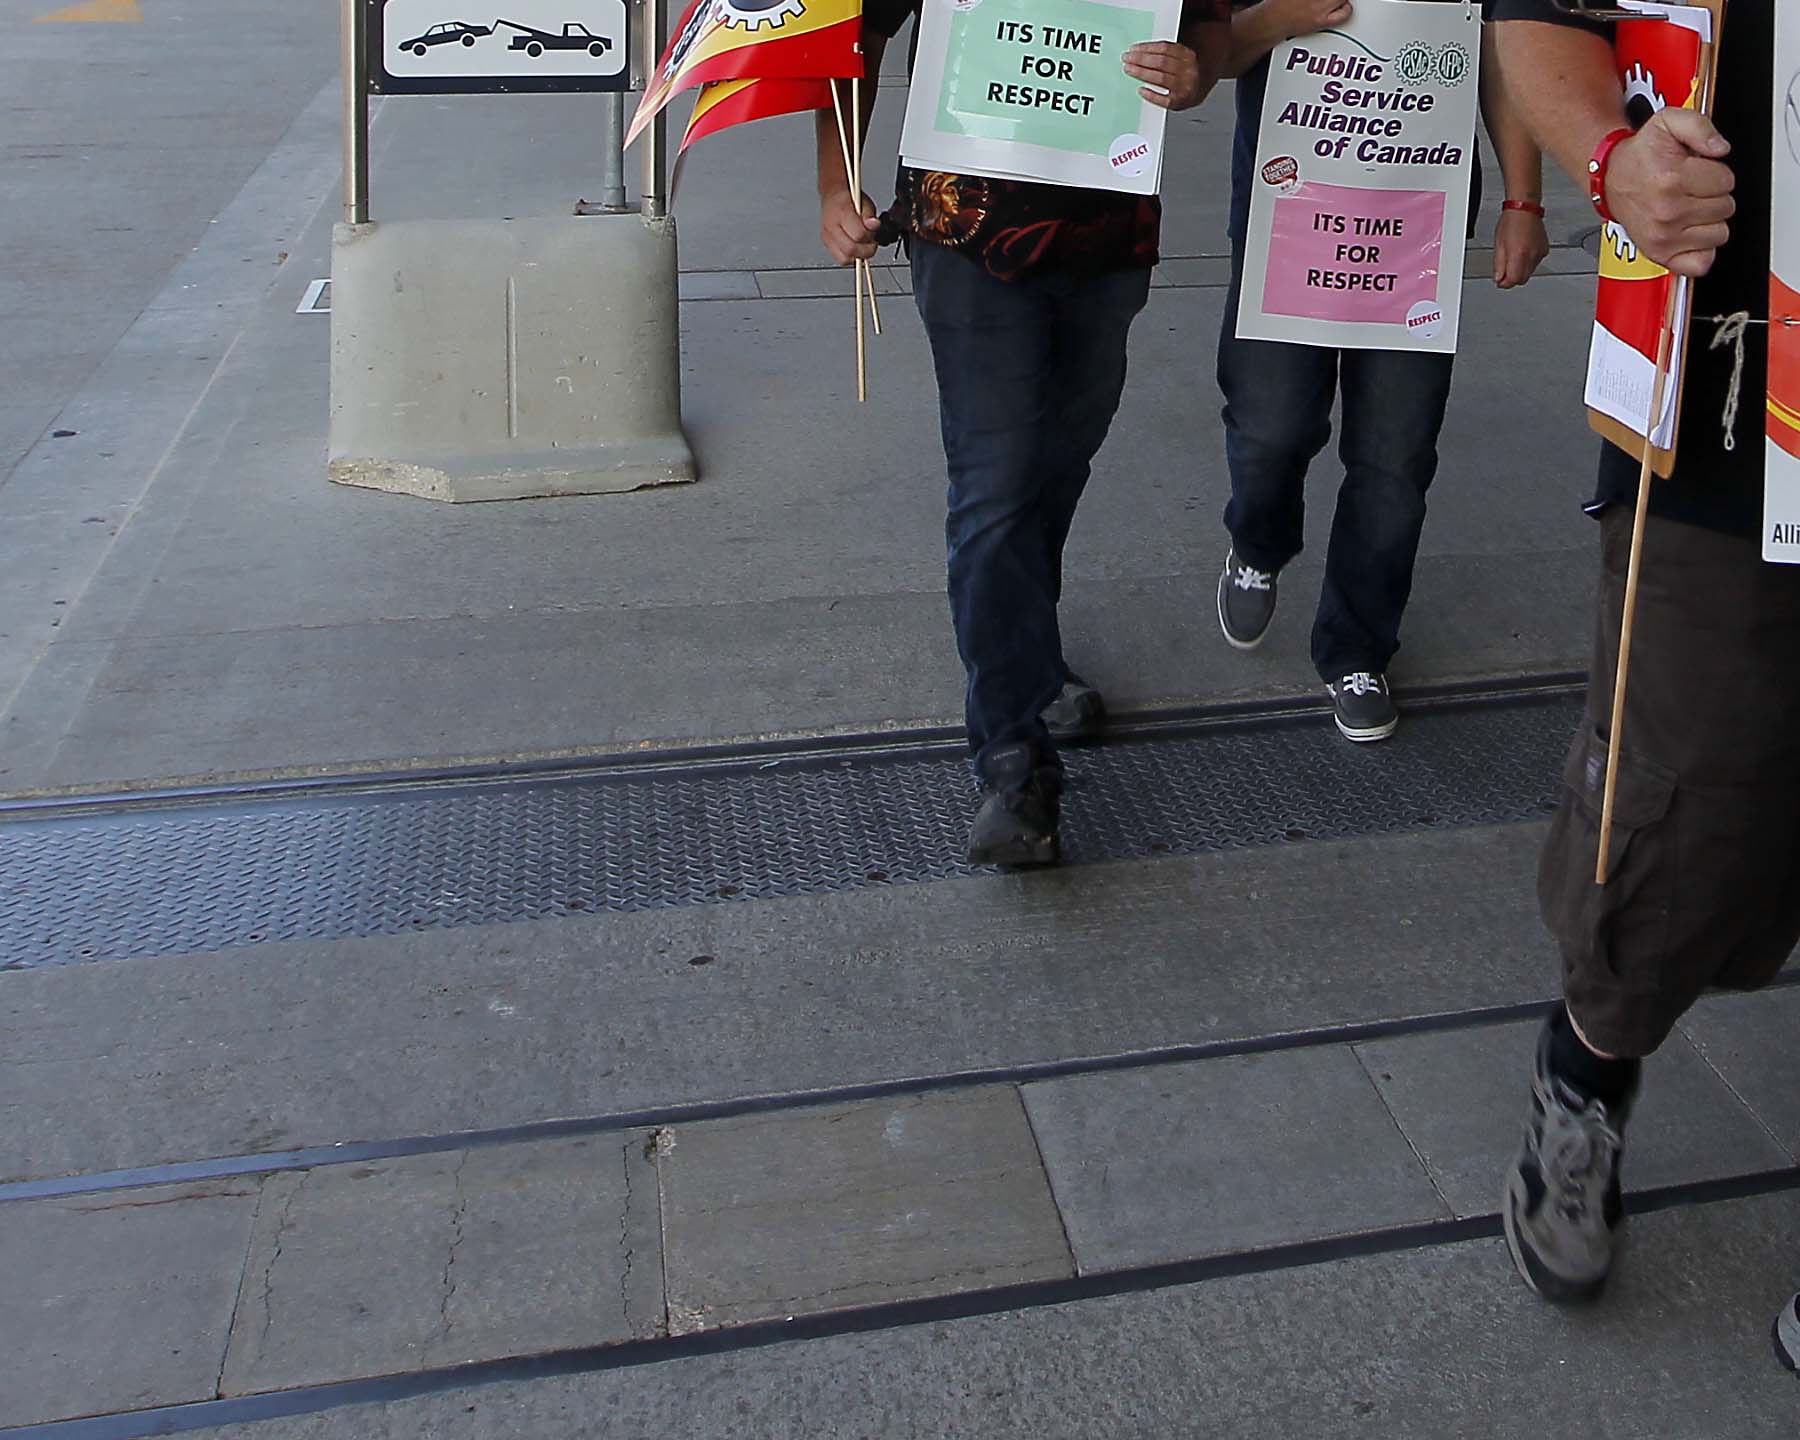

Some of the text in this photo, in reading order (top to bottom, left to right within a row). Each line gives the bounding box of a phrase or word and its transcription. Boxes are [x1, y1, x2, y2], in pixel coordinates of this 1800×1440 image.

[997, 21, 1102, 54] ITS TIME
[1021, 56, 1073, 81] FOR
[1287, 48, 1383, 81] Public
[987, 83, 1094, 116] RESPECT
[1321, 81, 1434, 112] Service
[1278, 102, 1402, 137] Alliance
[1112, 144, 1148, 167] RESPECT
[1314, 137, 1462, 165] of Canada
[1313, 213, 1403, 237] ITS TIME
[1336, 245, 1380, 263] FOR
[1306, 269, 1397, 292] RESPECT
[1408, 311, 1441, 328] RESPECT
